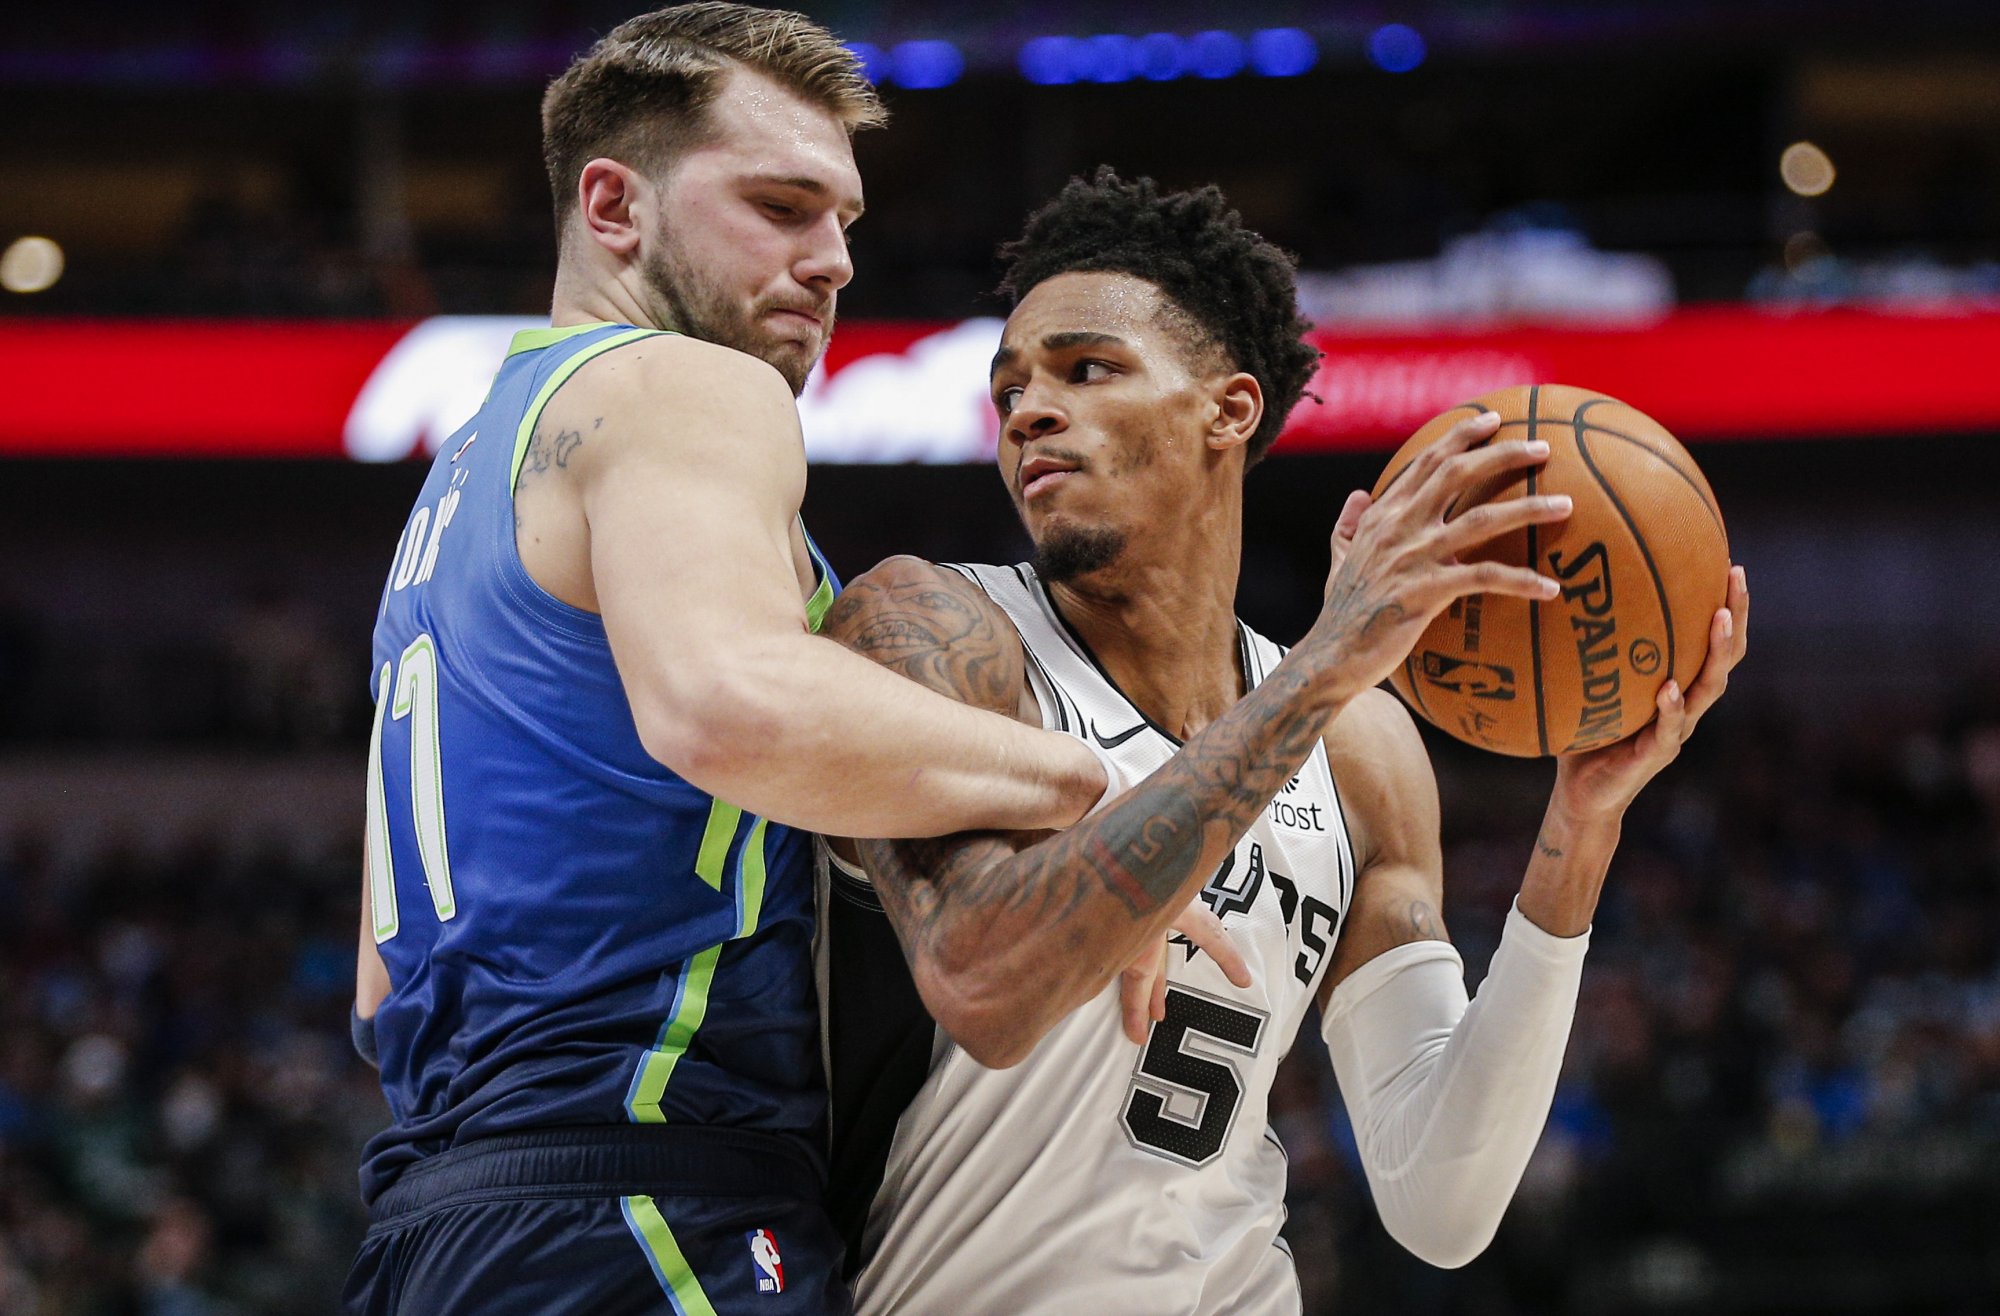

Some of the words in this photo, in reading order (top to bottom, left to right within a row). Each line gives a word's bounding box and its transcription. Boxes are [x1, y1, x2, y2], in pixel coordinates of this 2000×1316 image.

[1548, 541, 1623, 752] SPALDIN
[1269, 799, 1325, 832] rost
[1117, 980, 1271, 1170] 5
[760, 1278, 774, 1291] NBA
